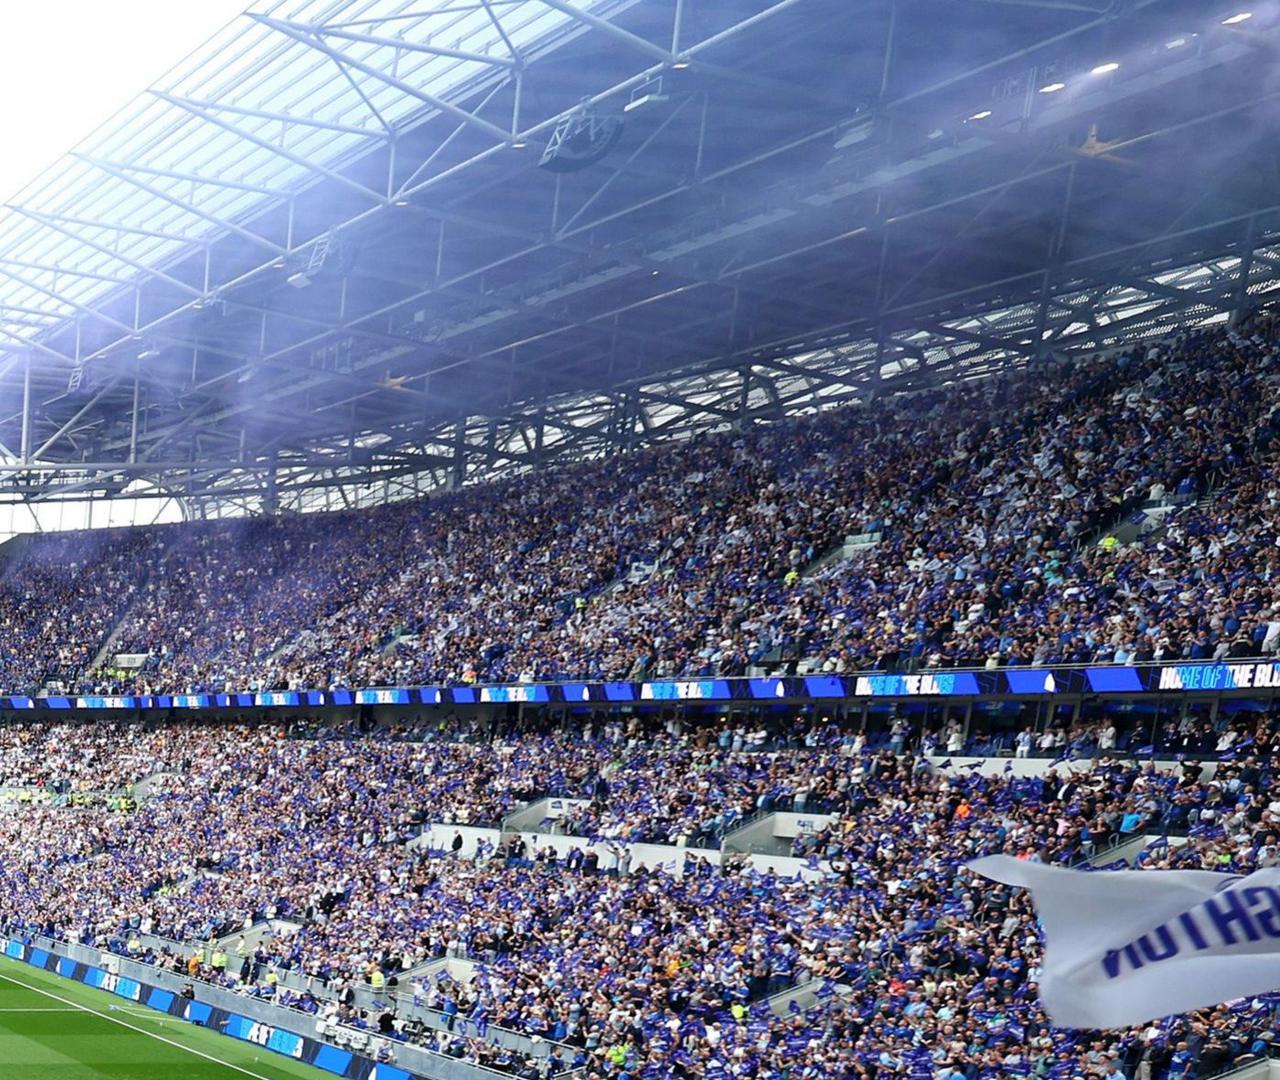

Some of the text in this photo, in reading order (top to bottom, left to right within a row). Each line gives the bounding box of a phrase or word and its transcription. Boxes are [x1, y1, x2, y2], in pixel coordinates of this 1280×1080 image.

[1159, 666, 1200, 689] HOME
[1202, 665, 1223, 689] OF
[1224, 664, 1255, 688] THE
